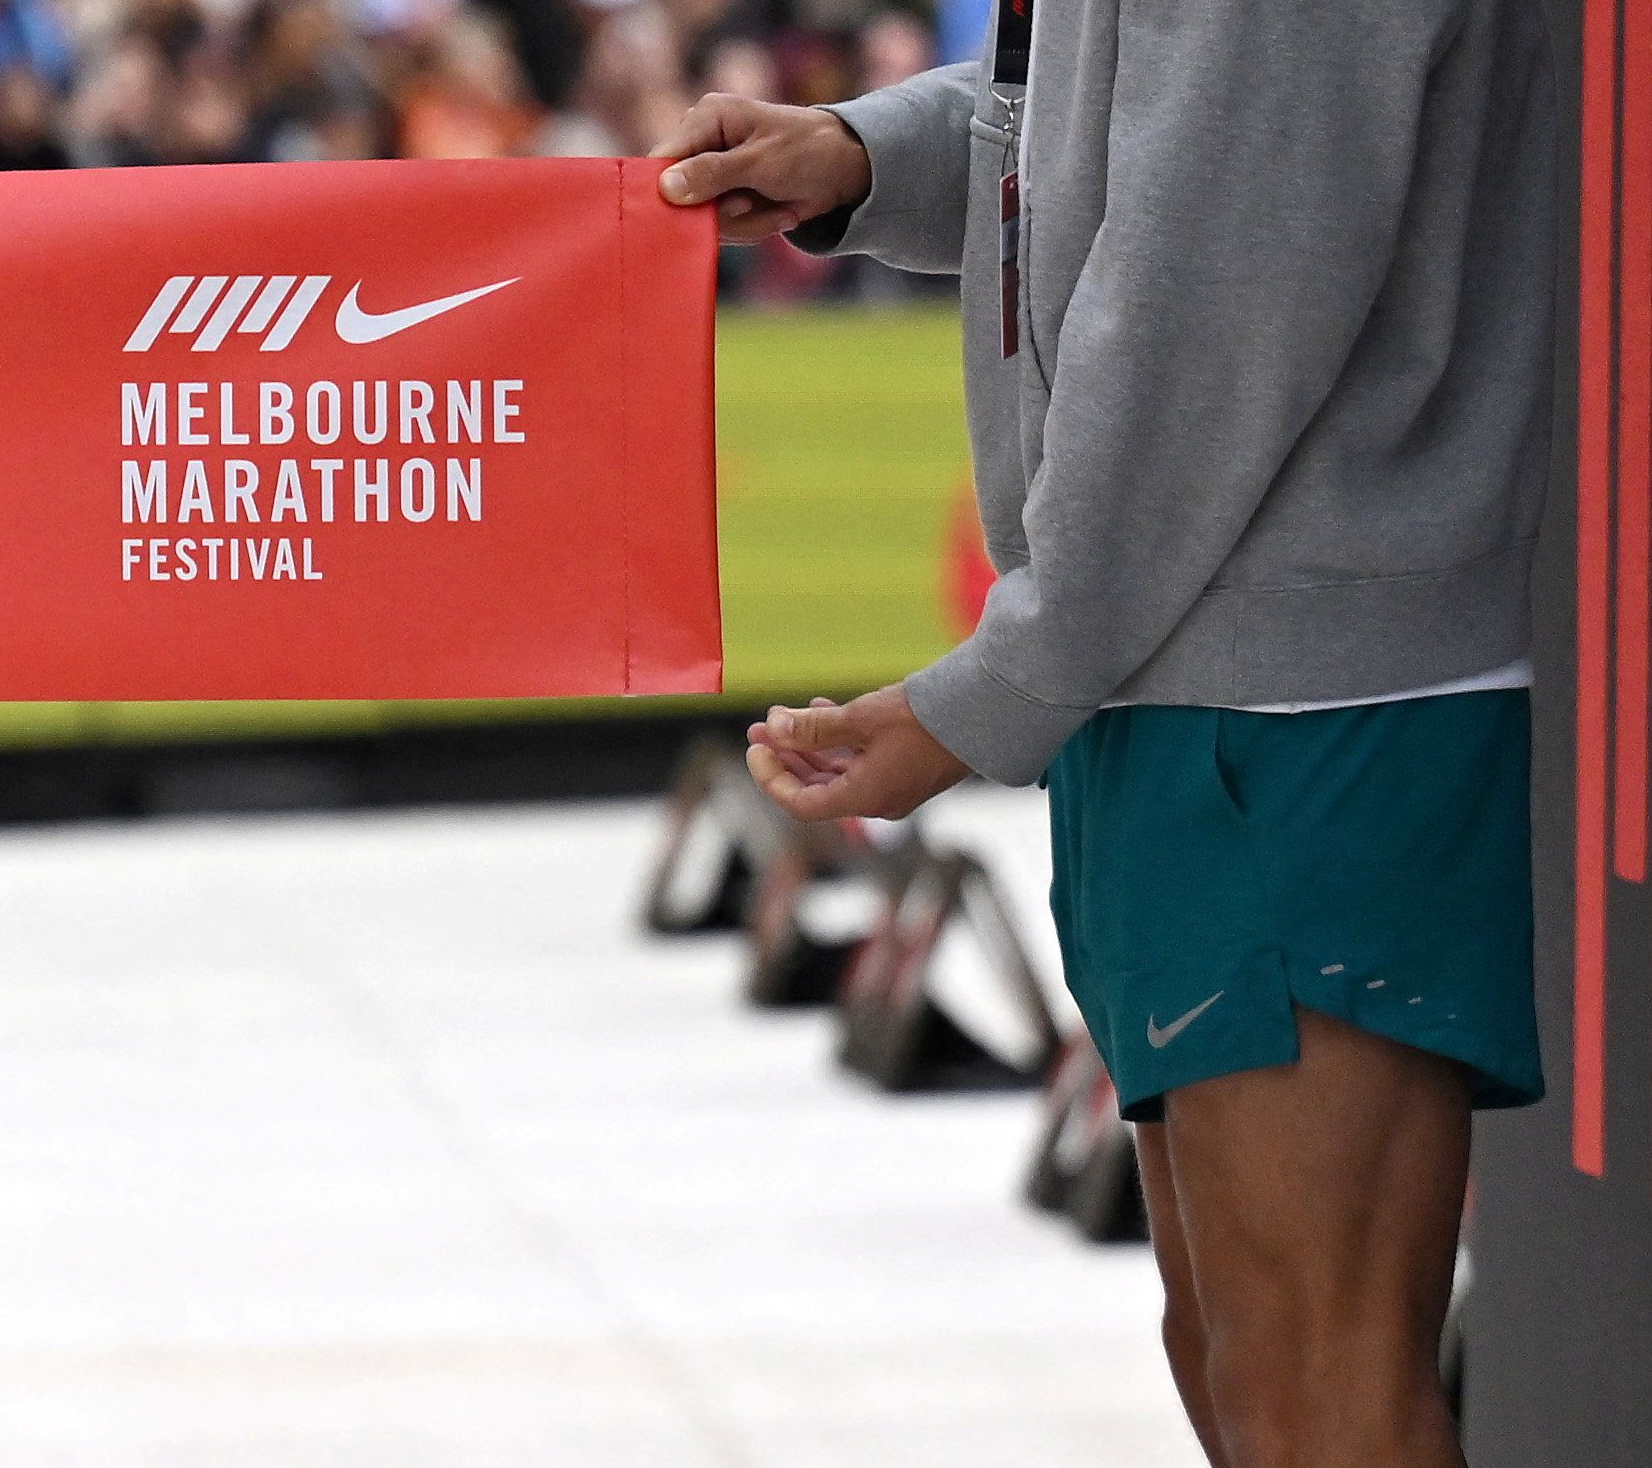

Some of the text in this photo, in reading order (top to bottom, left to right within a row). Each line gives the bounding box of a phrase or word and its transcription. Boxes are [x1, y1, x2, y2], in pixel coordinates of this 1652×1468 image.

[121, 379, 525, 446] MELBOURNE
[121, 457, 482, 523] MARATHON
[122, 538, 323, 581] FESTIVAL
